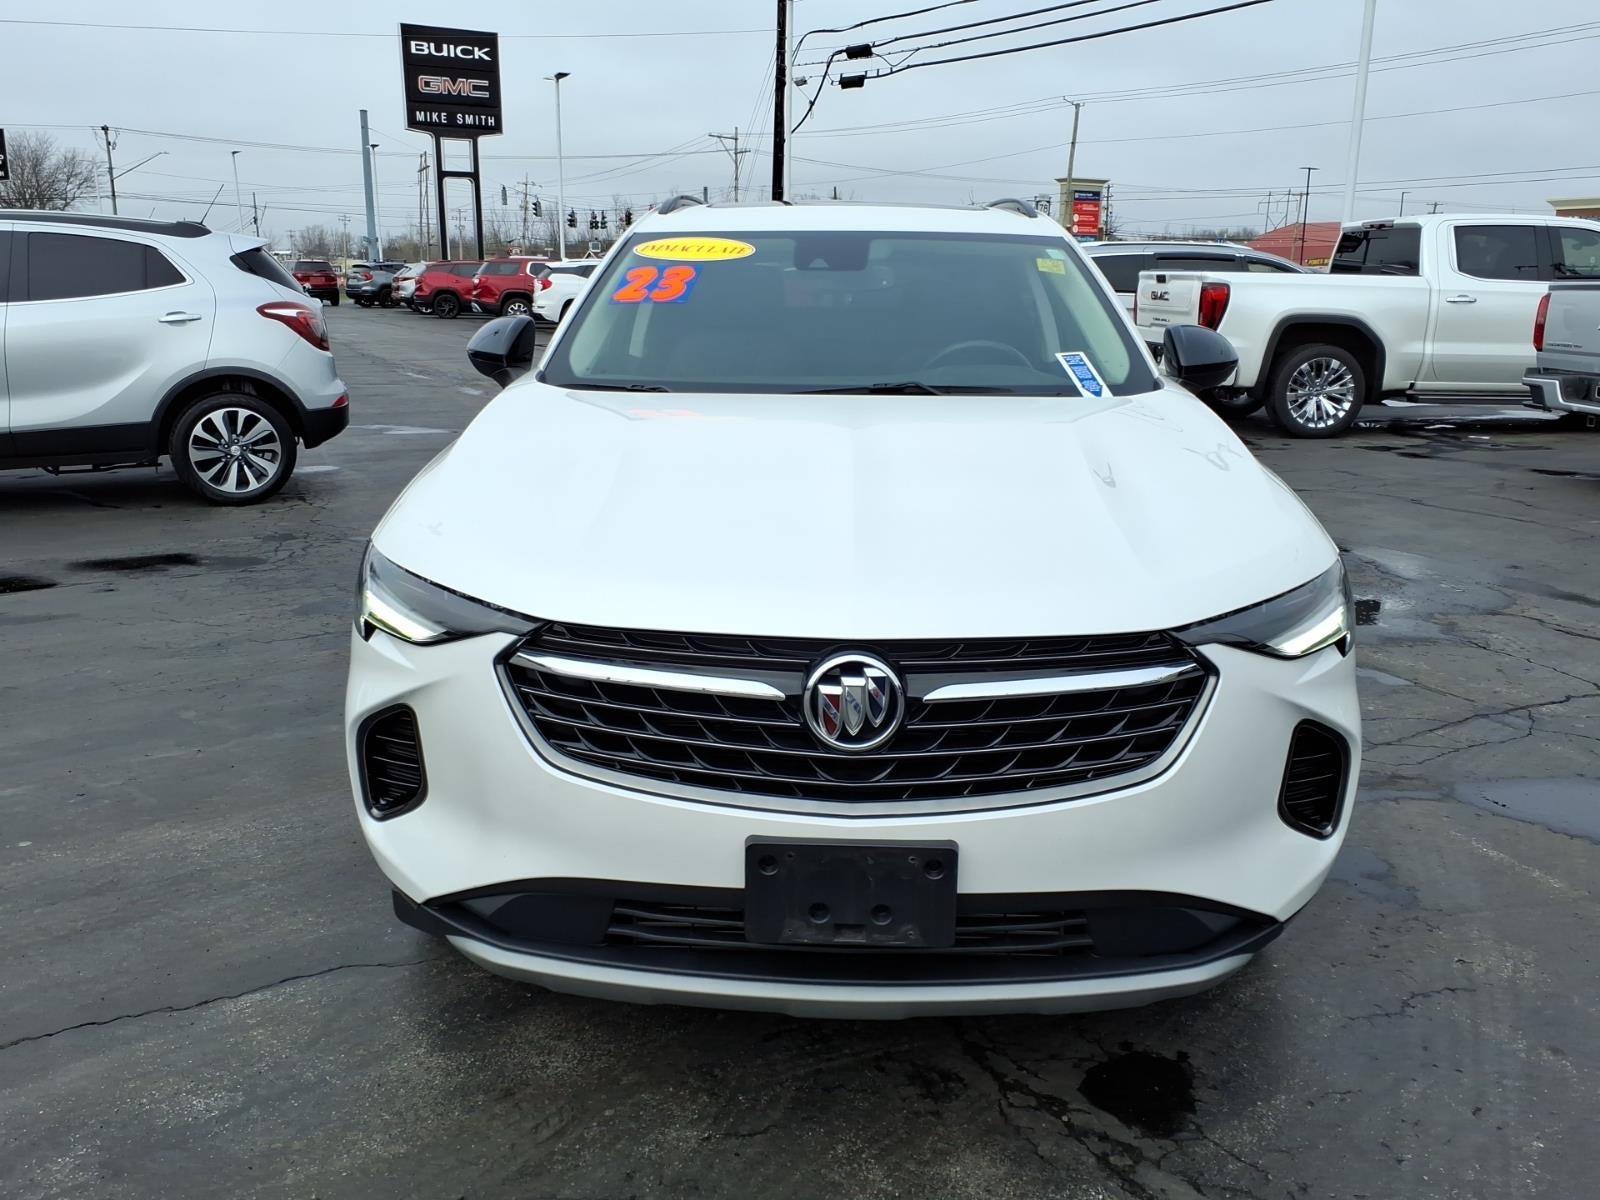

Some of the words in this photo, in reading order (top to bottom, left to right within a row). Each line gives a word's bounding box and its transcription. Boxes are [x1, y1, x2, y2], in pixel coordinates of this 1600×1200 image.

[410, 40, 492, 61] BUICK
[418, 75, 490, 98] GMC
[416, 110, 448, 123] MIKE
[456, 113, 495, 127] SMITH
[612, 265, 696, 303] 23
